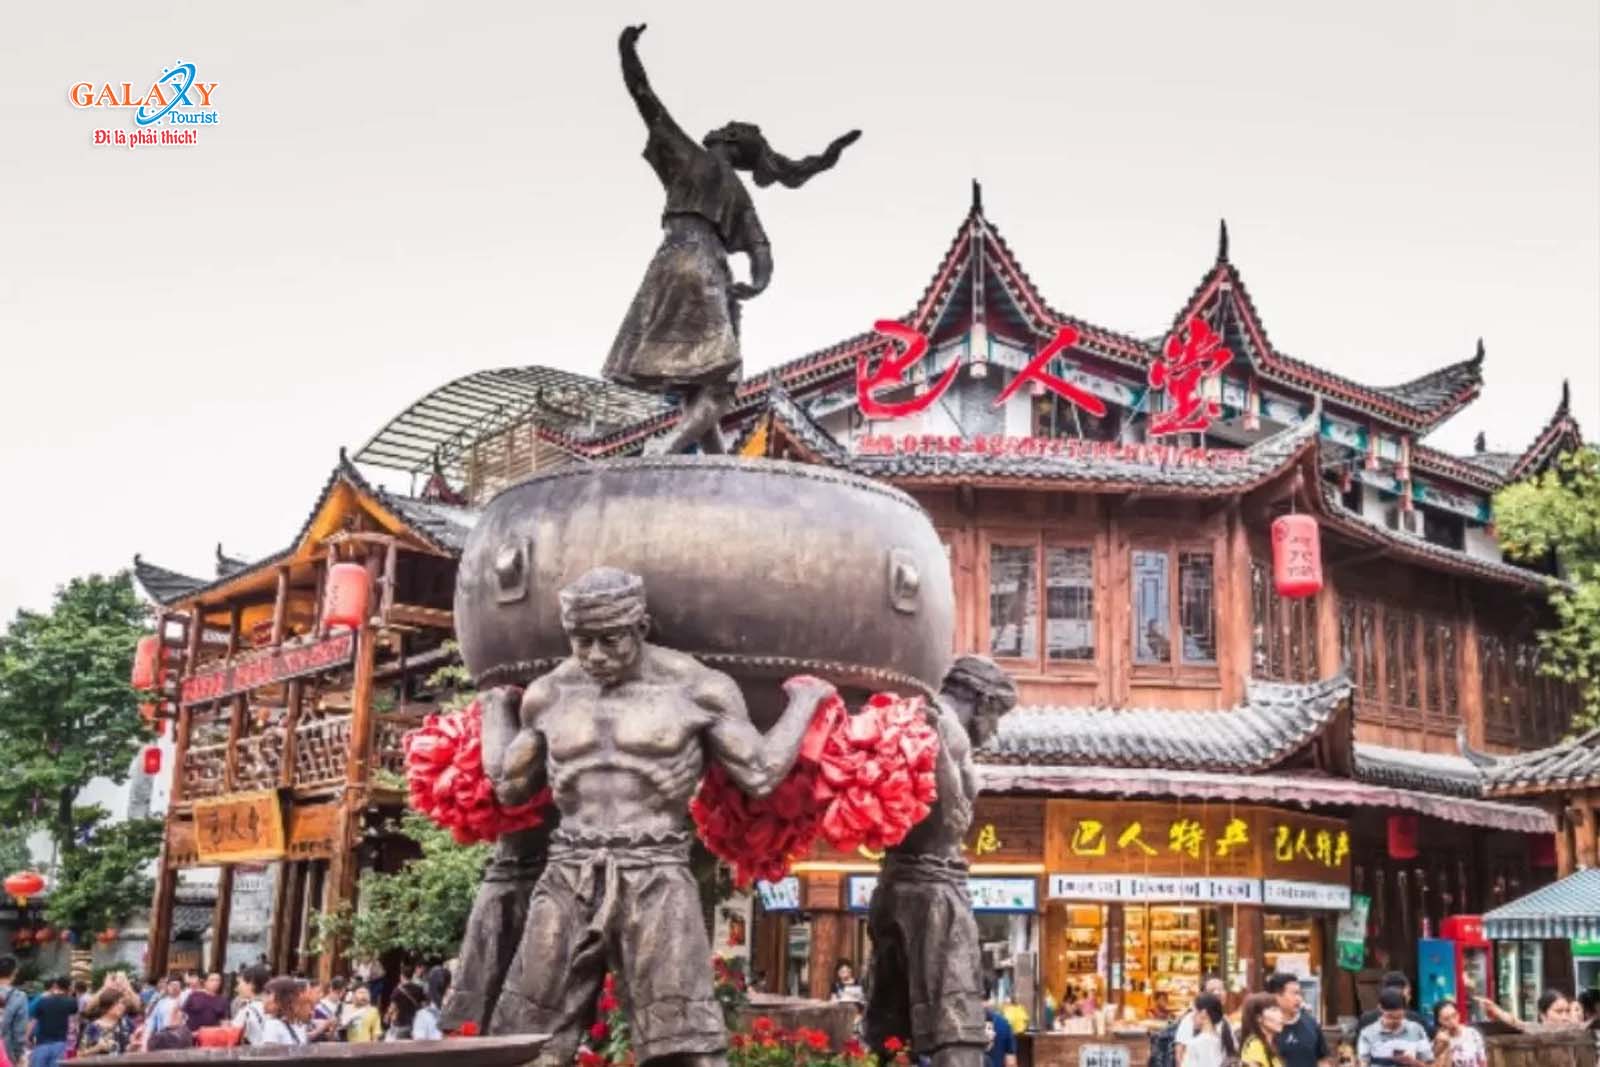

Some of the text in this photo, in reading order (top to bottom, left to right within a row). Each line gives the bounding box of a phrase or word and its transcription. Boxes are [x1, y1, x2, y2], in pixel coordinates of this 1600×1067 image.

[856, 318, 1234, 437] 巴人堂
[1071, 818, 1249, 858] 巴人特产
